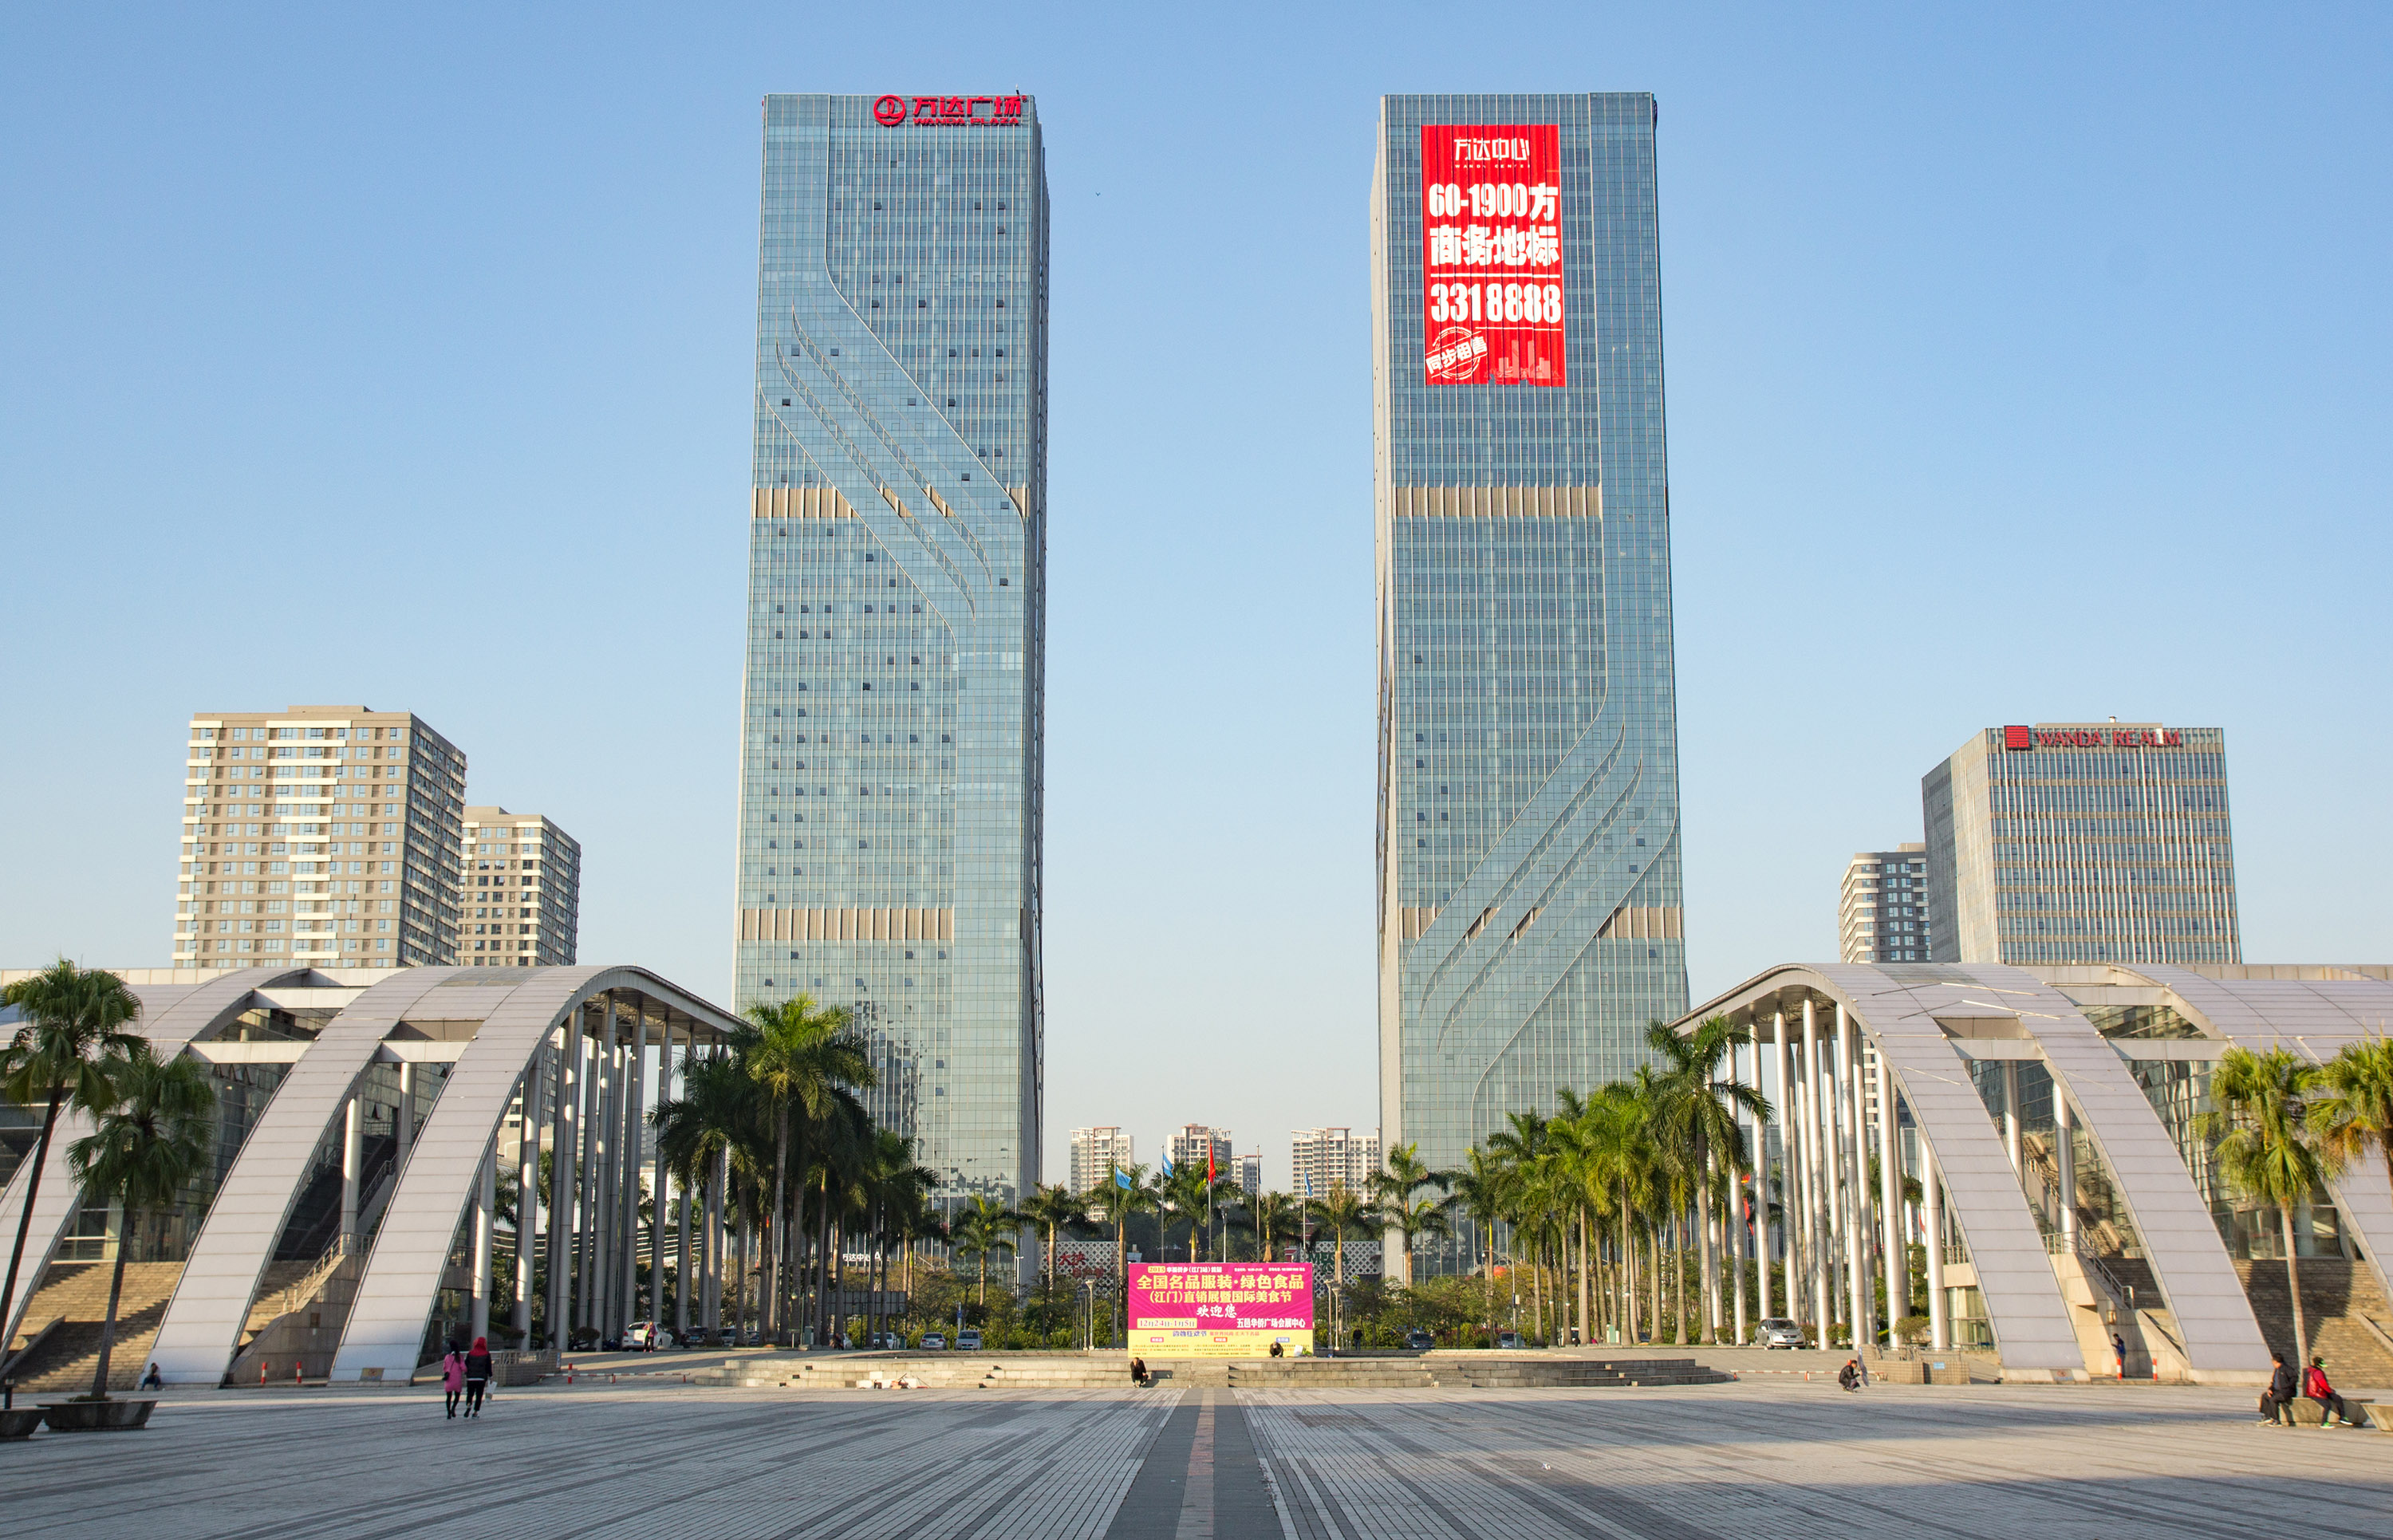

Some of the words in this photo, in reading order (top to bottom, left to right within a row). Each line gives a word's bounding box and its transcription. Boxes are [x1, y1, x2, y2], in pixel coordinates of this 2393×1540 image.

[913, 96, 1021, 116] 万达广场
[1454, 138, 1530, 160] 万达中心
[1429, 183, 1559, 222] 60-1900方
[1429, 224, 1559, 267] 商务地标
[1430, 283, 1562, 324] 3318888
[1426, 336, 1488, 374] 同步租售
[2036, 731, 2103, 746] WANDA
[2113, 731, 2180, 746] REALM
[1137, 1274, 1304, 1290] 全国名品服装·绿色食品
[1149, 1290, 1292, 1303] (江门)直销展暨国际美食节
[1196, 1303, 1237, 1318] 欢迎您
[1236, 1317, 1306, 1328] 五邑华侨广场会展中心
